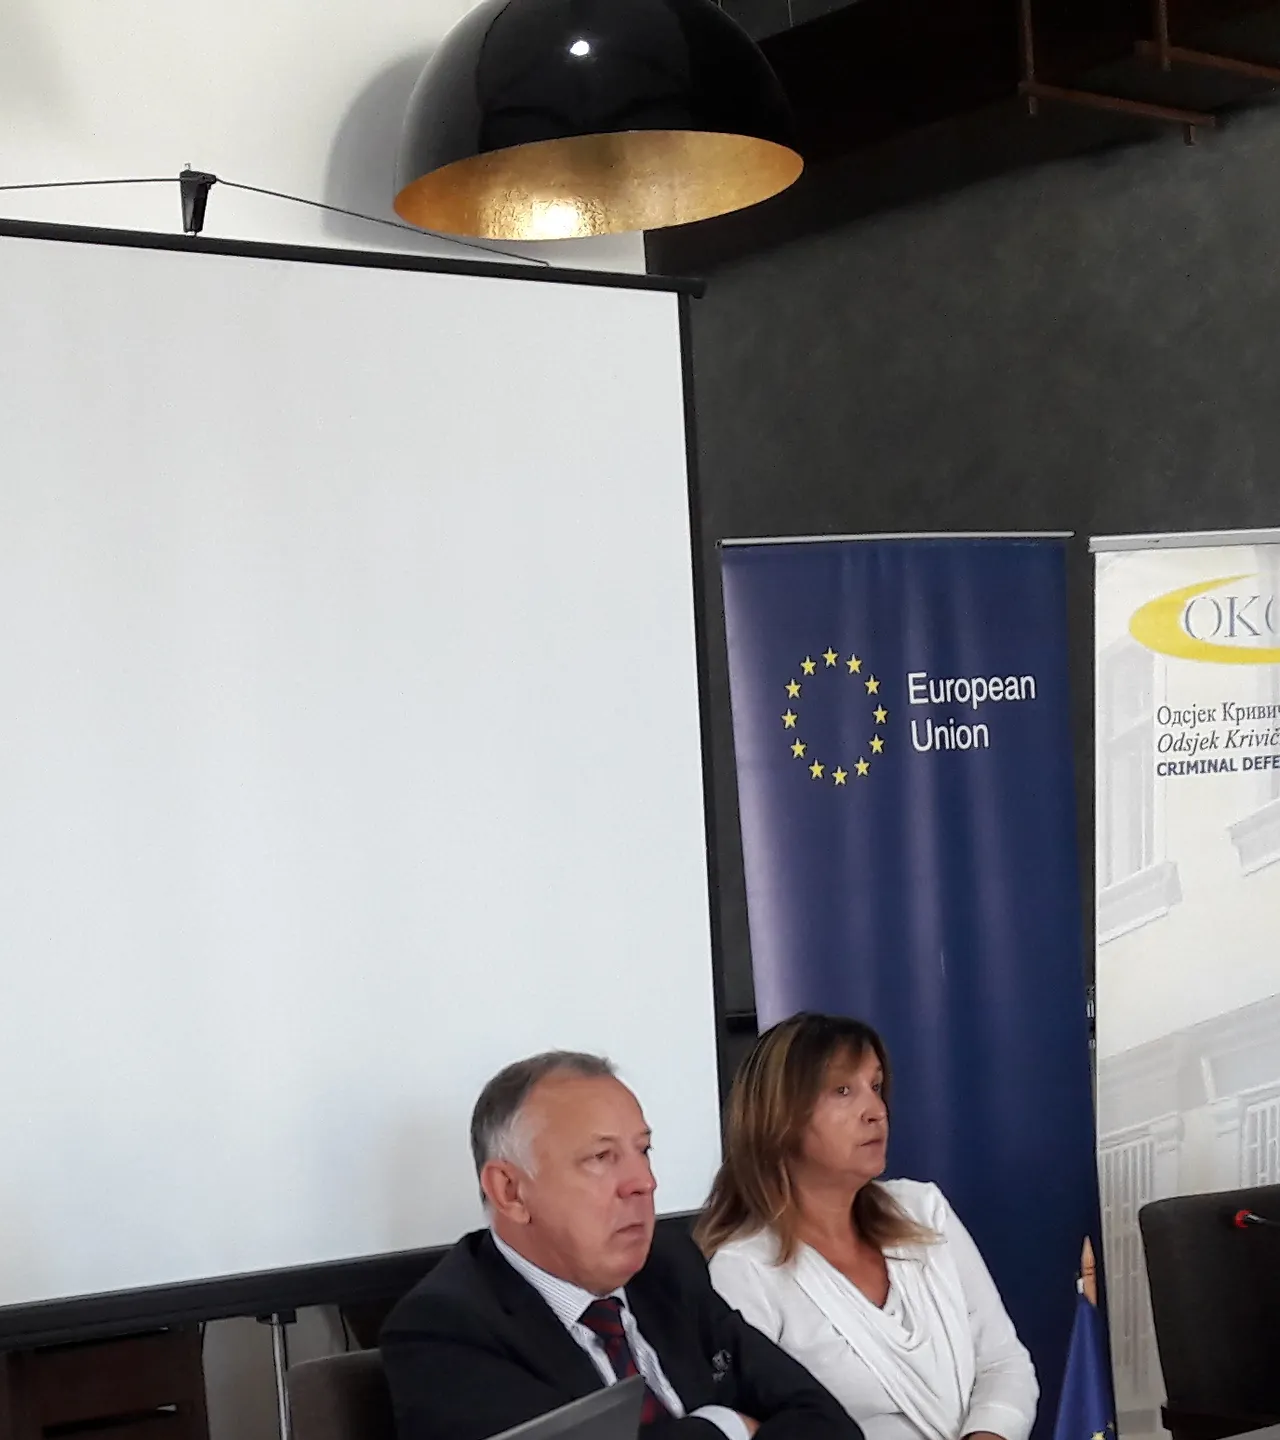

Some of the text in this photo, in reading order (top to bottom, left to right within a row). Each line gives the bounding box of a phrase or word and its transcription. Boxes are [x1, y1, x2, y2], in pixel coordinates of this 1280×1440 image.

[907, 671, 1036, 710] European
[1157, 705, 1216, 729] Одсјек
[910, 718, 990, 752] Union
[1157, 729, 1219, 756] Odsjek
[1157, 757, 1238, 776] CRIMINAL
